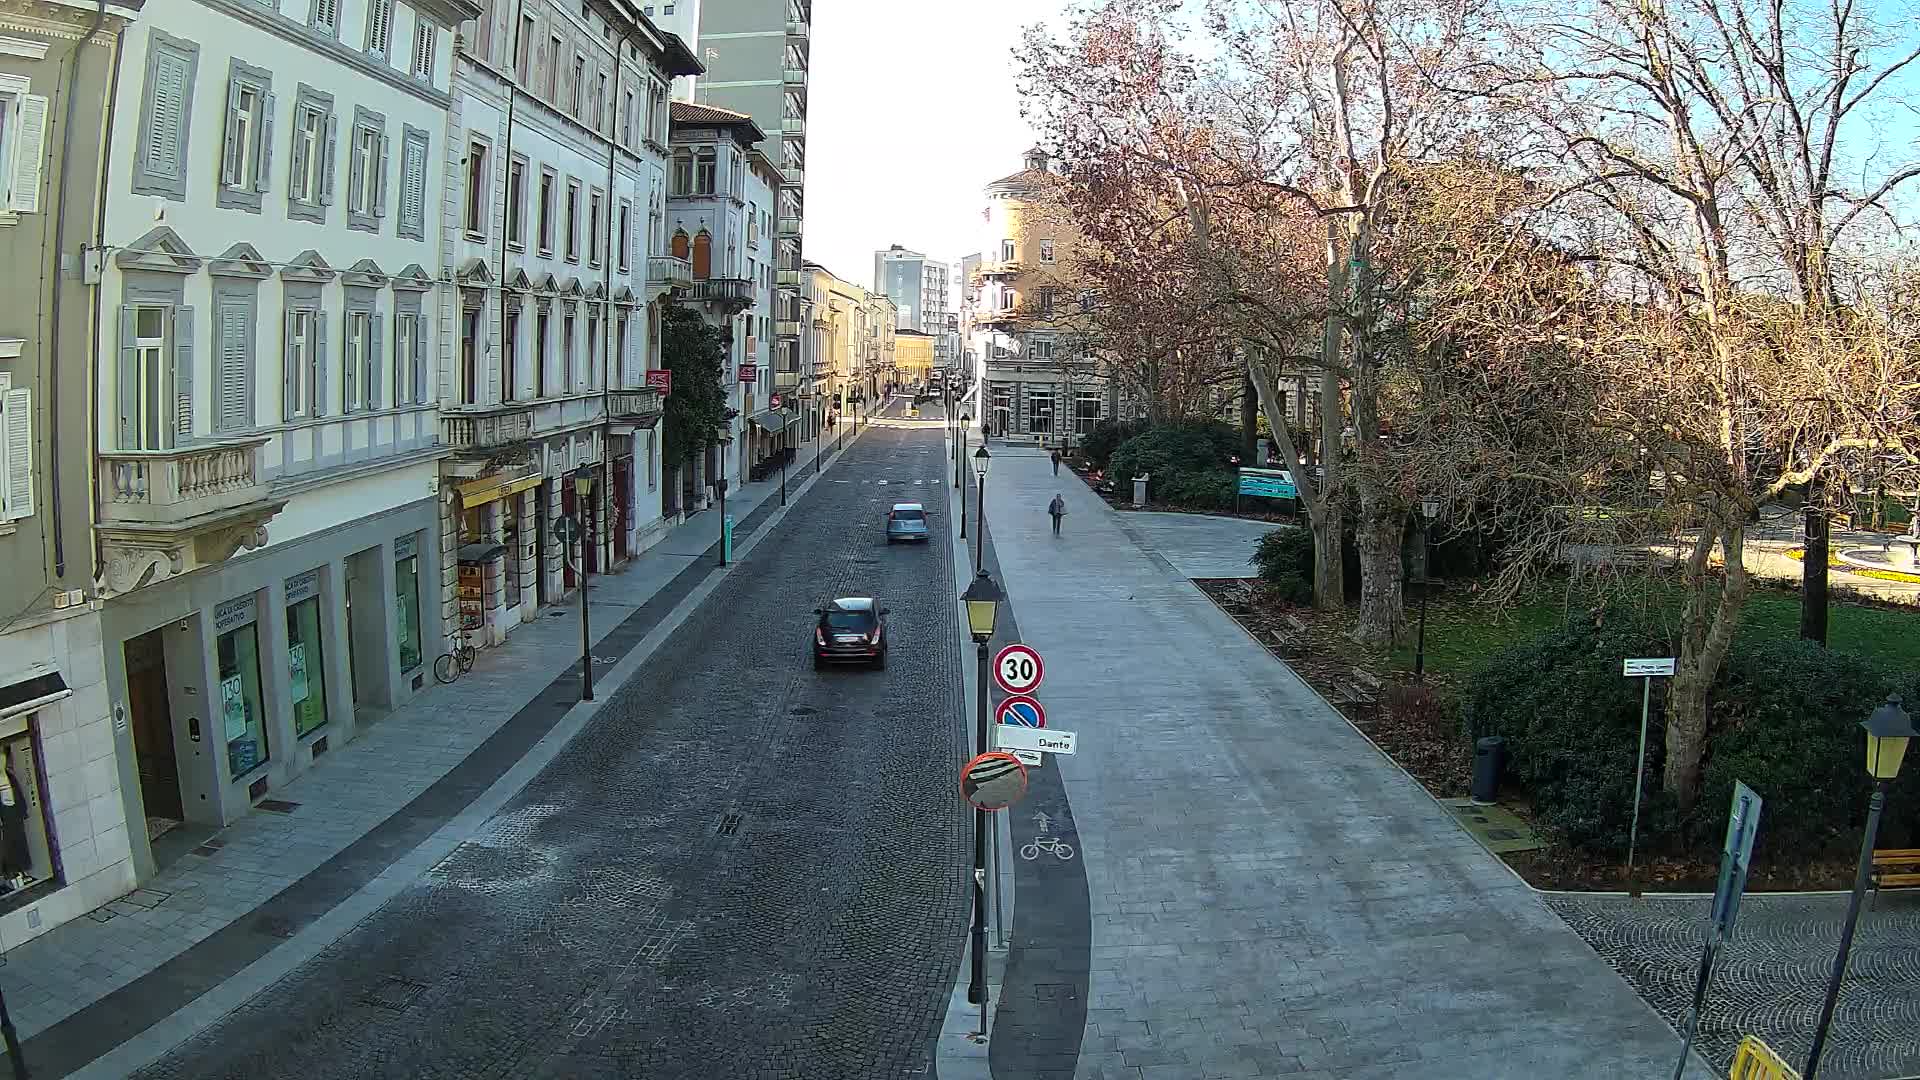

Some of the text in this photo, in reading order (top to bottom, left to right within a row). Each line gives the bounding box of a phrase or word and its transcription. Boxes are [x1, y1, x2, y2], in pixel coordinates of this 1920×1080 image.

[1006, 658, 1033, 680] 30
[223, 678, 240, 700] 130
[1039, 738, 1070, 750] Dante
